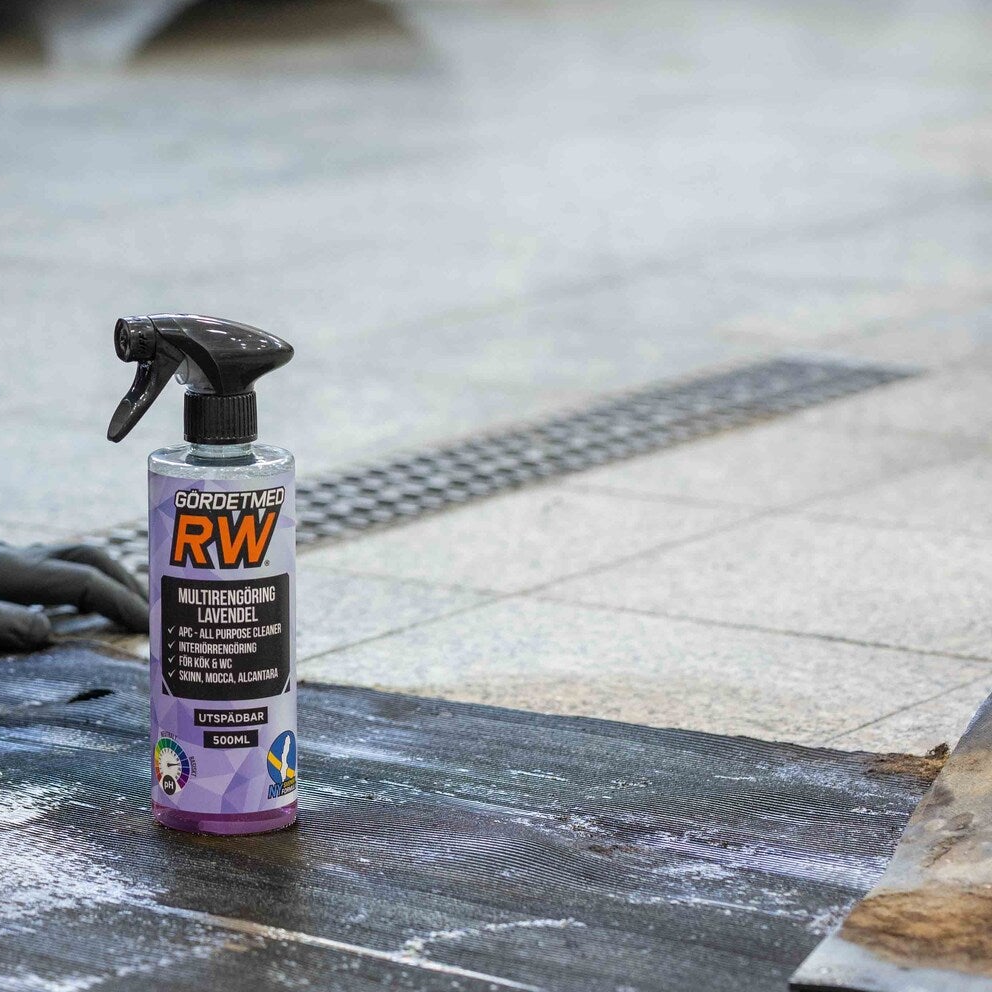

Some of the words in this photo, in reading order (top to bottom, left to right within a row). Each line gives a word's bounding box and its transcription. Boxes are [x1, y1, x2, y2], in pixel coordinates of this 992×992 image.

[175, 487, 285, 510] GÖRDETMED
[173, 511, 276, 564] RW
[178, 585, 276, 606] MULTIRENGÖRING
[198, 606, 259, 623] LAVENDEL
[178, 626, 193, 638] APC
[199, 628, 214, 639] ALL
[215, 627, 252, 639] PURPOSE
[252, 623, 282, 638] CLEANER
[178, 641, 257, 655] INTERIÖRRENGÖRING
[178, 654, 193, 668] FÖR
[194, 655, 210, 668] KÖK
[211, 658, 218, 668] &
[219, 658, 233, 669] WC
[178, 670, 204, 684] SKINN,
[205, 672, 236, 684] MOCCA,
[237, 668, 279, 683] ALCANTARA
[198, 711, 264, 724] UTSPÄDBAR
[213, 735, 250, 745] 500ML
[164, 780, 174, 790] pH
[268, 784, 283, 799] NY
